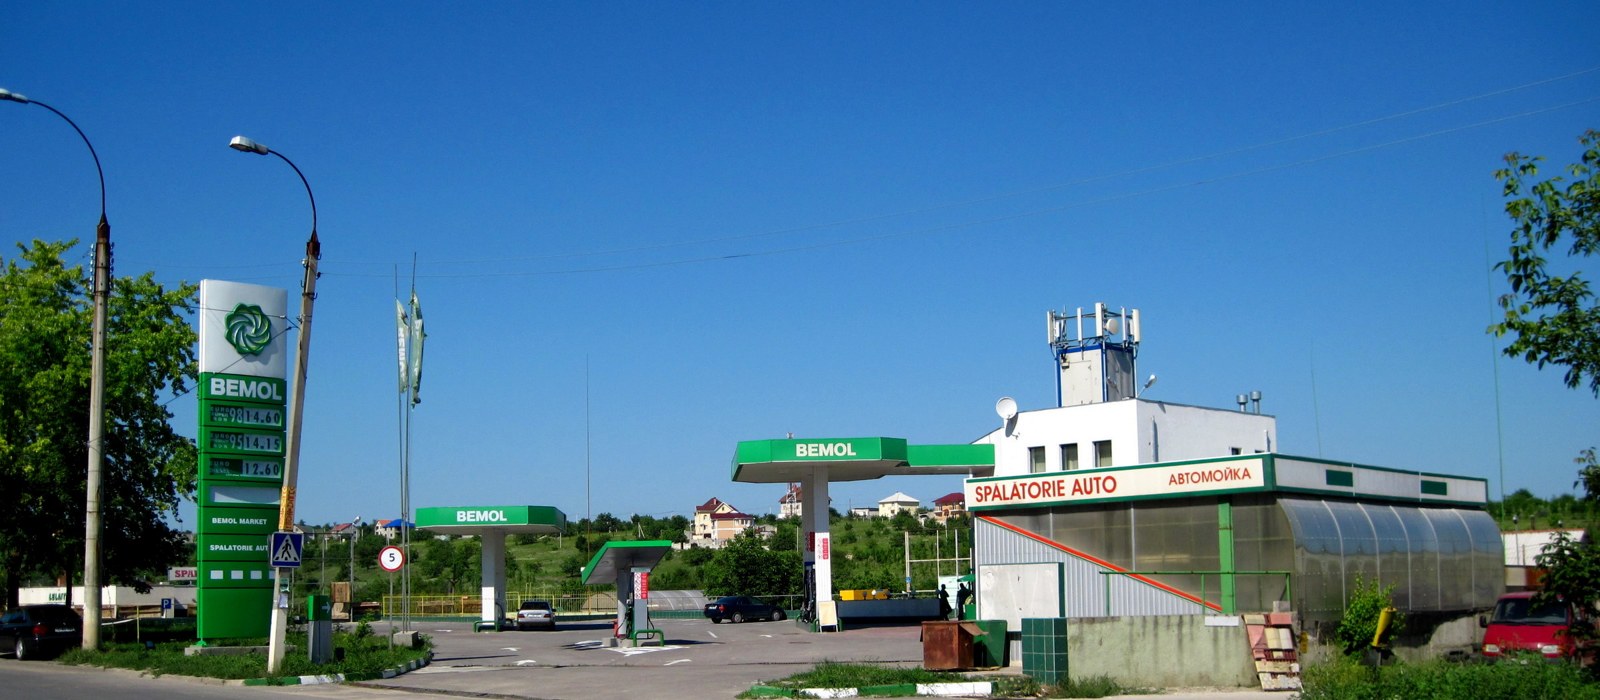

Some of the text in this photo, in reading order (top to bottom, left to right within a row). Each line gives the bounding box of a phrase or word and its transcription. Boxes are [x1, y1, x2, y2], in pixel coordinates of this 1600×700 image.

[210, 377, 282, 400] BEMOL
[229, 407, 280, 424] 98 14.60
[229, 434, 280, 450] 95 14.15
[796, 443, 856, 457] BEMOL
[245, 463, 279, 475] 12.60
[1168, 467, 1252, 486] АВТОМОЙКА
[1071, 475, 1117, 496] AUTO
[457, 510, 507, 522] BEMOL
[389, 553, 395, 562] 5
[175, 570, 197, 578] SPA
[163, 599, 170, 609] P
